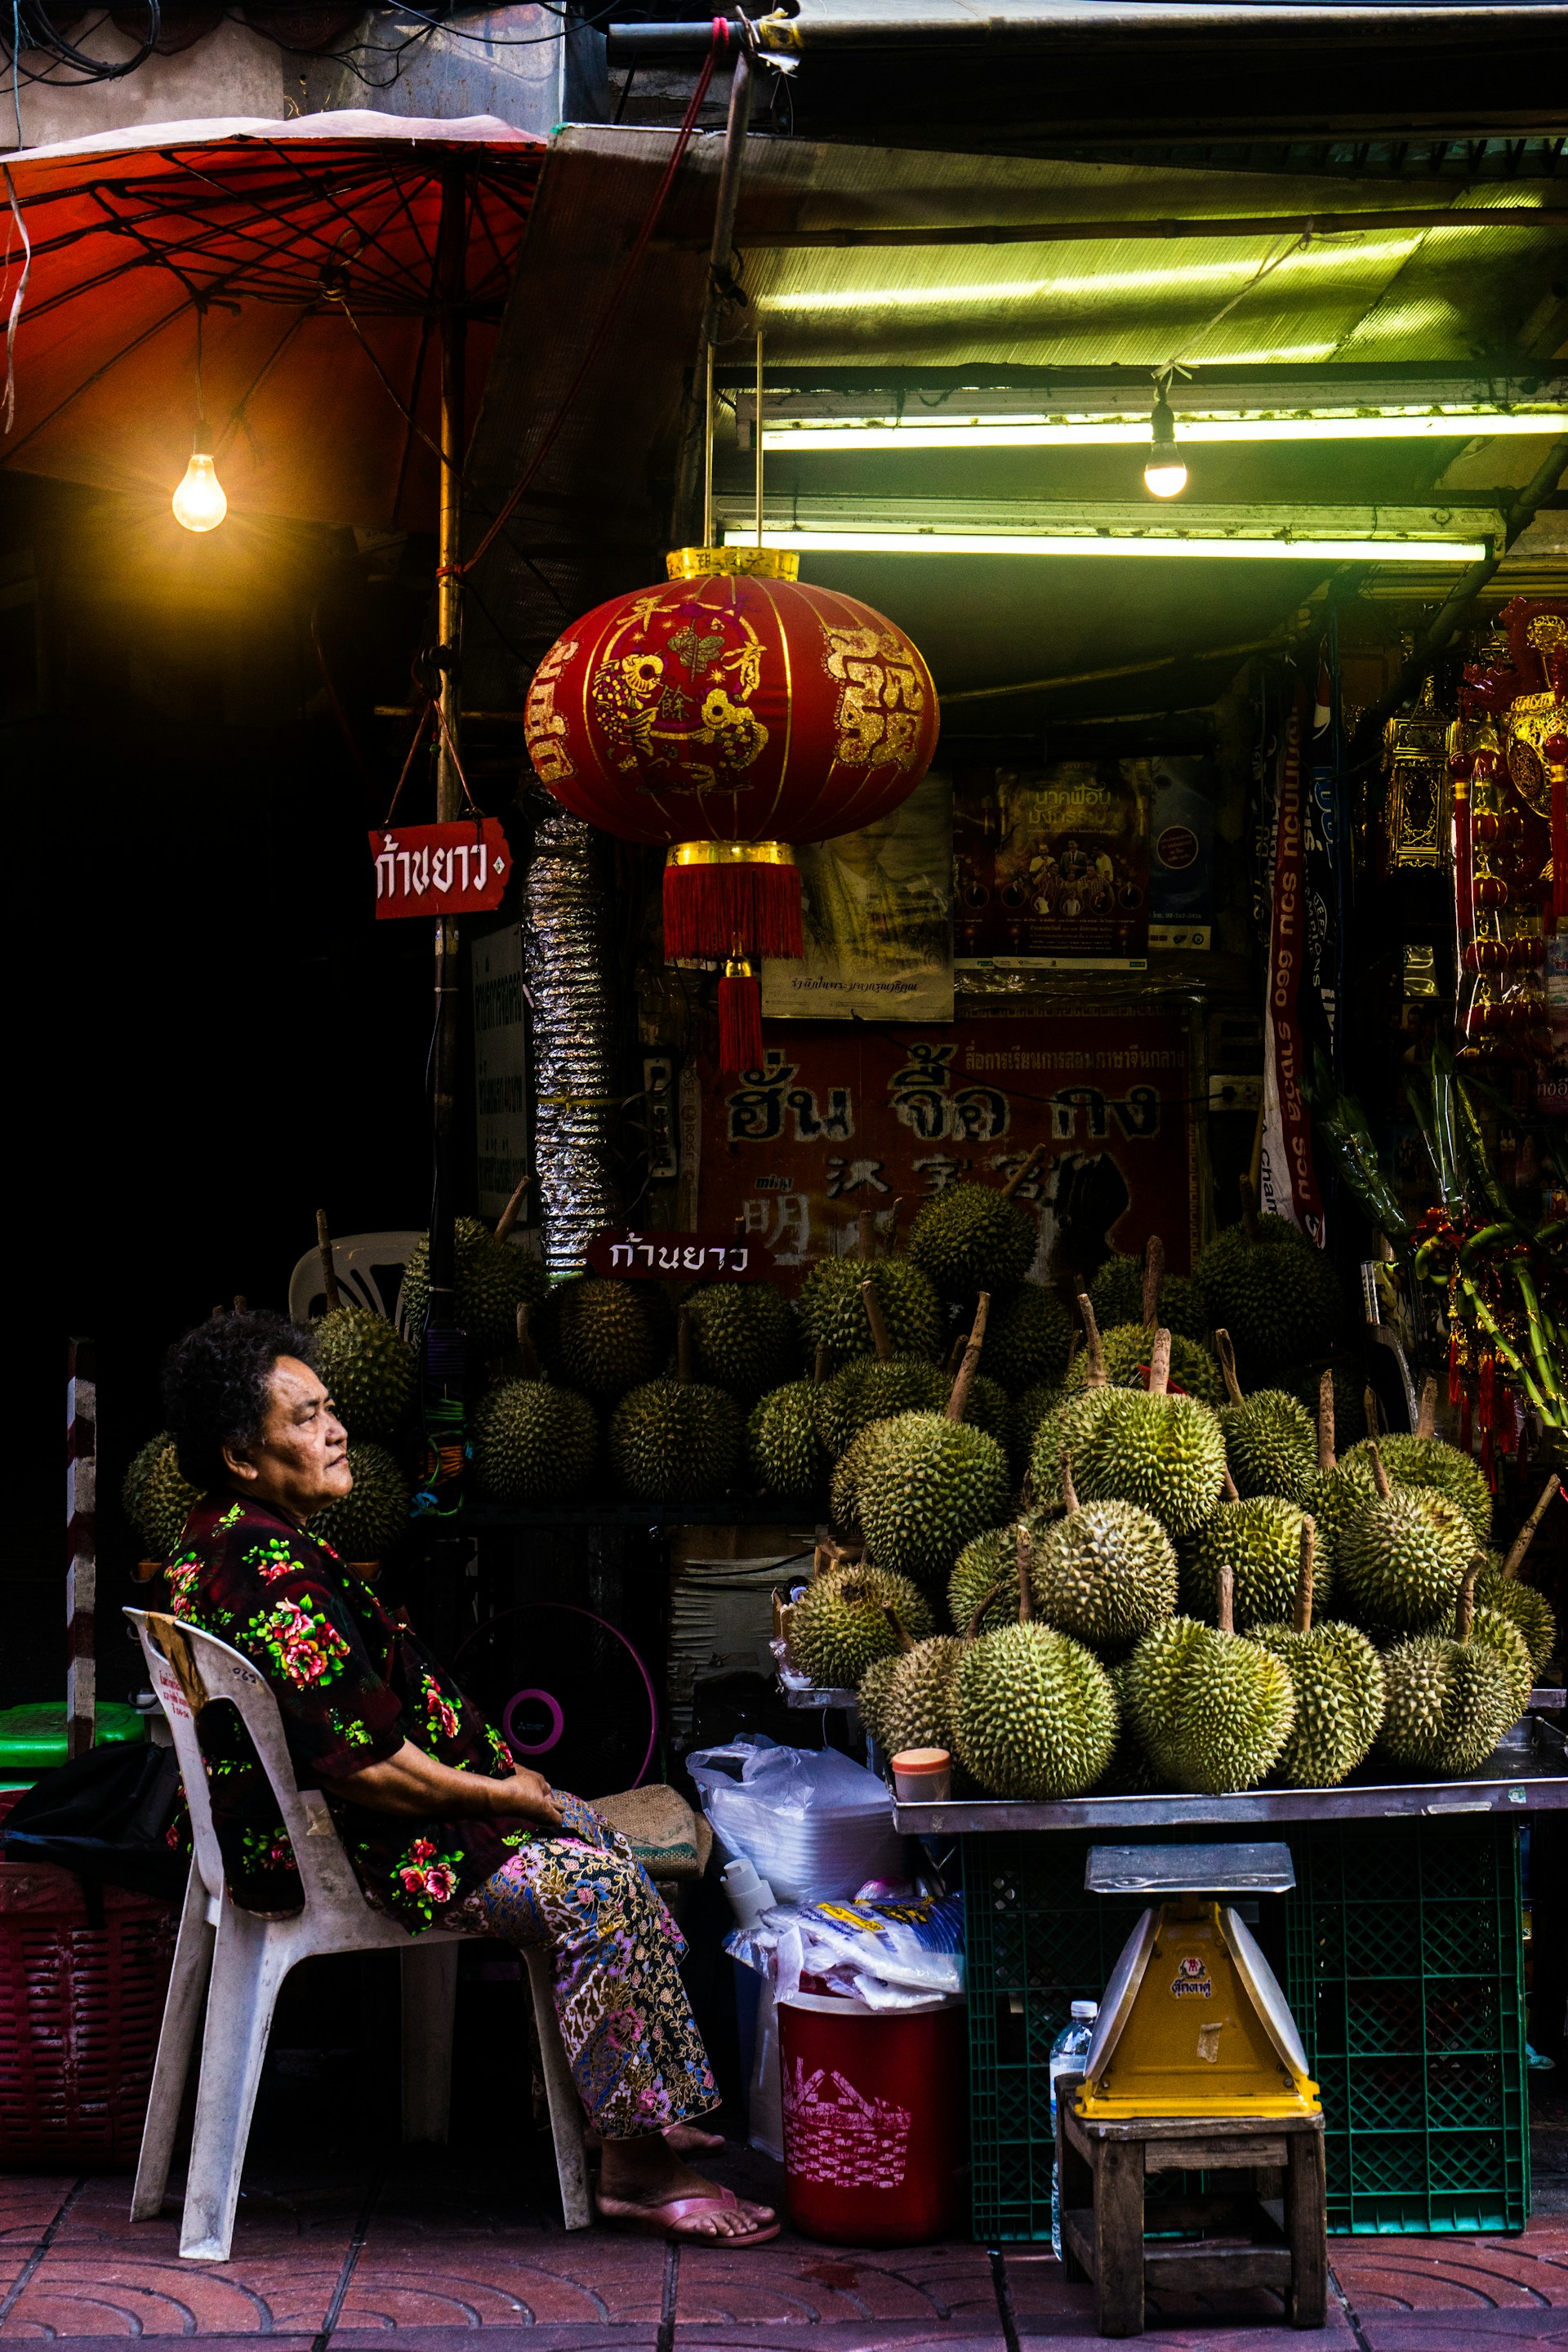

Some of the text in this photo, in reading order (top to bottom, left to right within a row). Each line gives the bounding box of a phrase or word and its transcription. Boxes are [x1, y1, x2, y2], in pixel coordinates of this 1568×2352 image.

[374, 833, 488, 899] ก้านยาว
[1274, 949, 1294, 1008] 660
[1049, 1084, 1162, 1143] กง
[608, 1231, 749, 1273] ก้านยาว
[1171, 1977, 1212, 1998] ตุ๊กตาคู่
